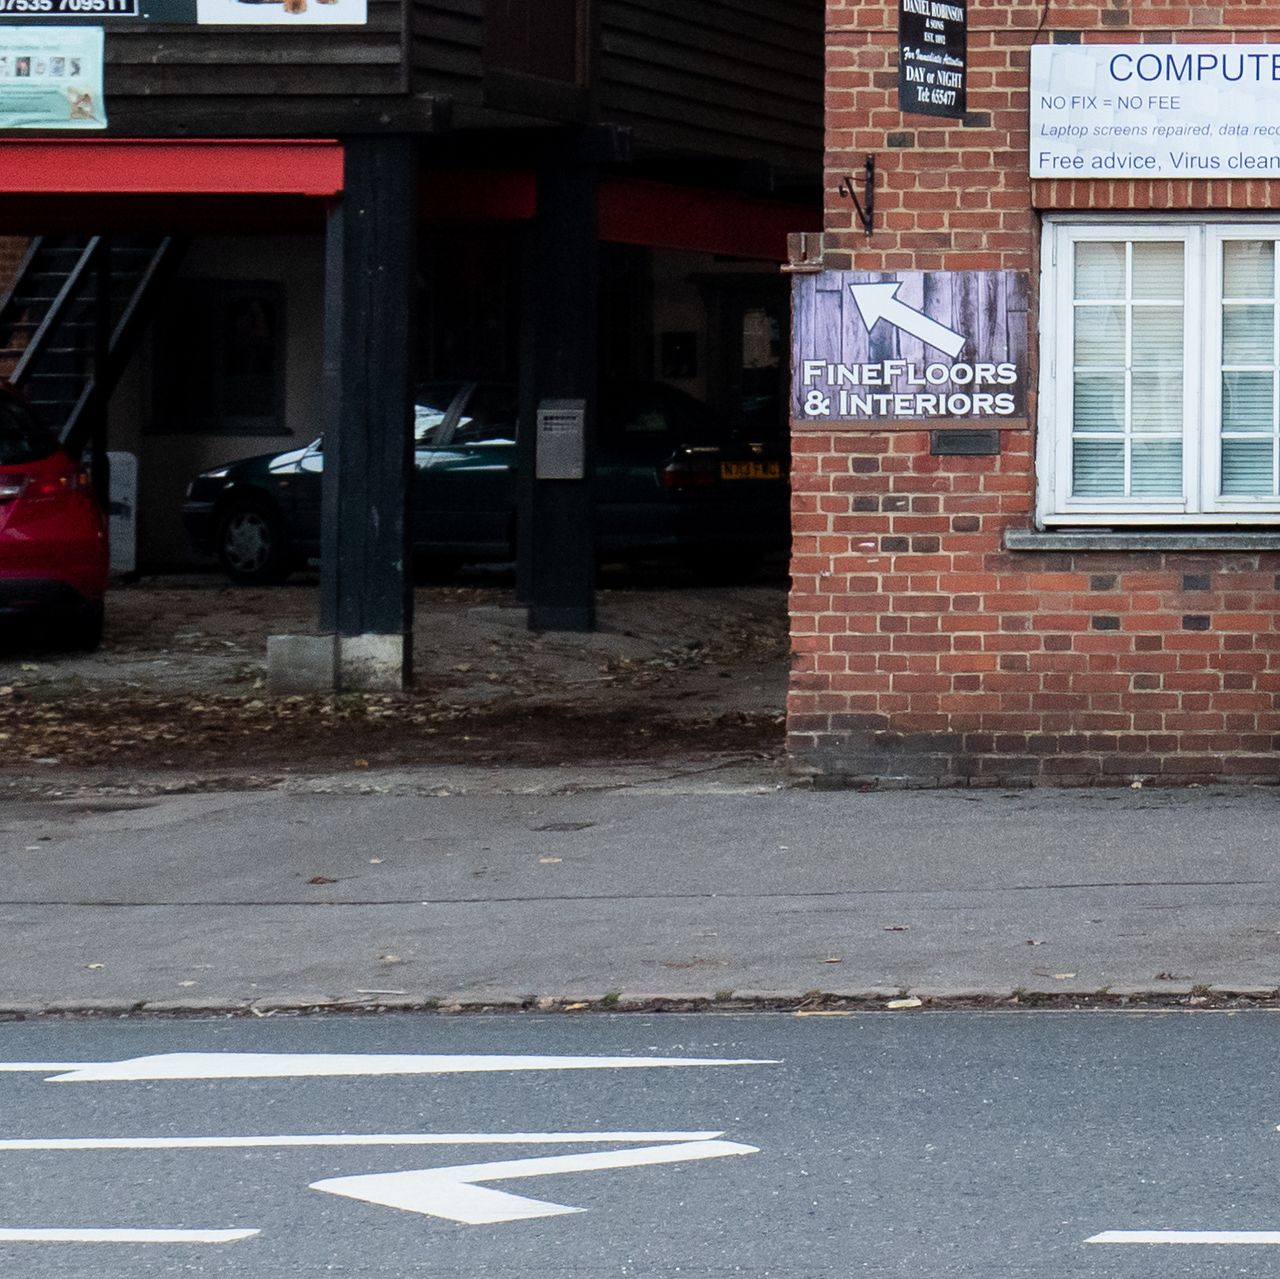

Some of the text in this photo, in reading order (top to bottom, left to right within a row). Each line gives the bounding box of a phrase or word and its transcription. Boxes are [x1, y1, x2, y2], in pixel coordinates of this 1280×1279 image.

[931, 2, 964, 22] ROBINSON
[903, 46, 915, 60] For
[906, 66, 962, 89] DAY or NIGHT
[1041, 96, 1066, 109] NO
[1071, 96, 1097, 109] FIX
[1117, 96, 1143, 109] NO
[1148, 96, 1181, 109] FEE
[1040, 123, 1089, 138] Laptop
[1093, 124, 1148, 136] screens
[1152, 123, 1213, 138] repaired,
[1218, 123, 1249, 136] data
[1038, 152, 1084, 169] Free
[1091, 152, 1162, 172] advice,
[1169, 152, 1221, 169] Virus
[804, 390, 1016, 416] & INTERIORS
